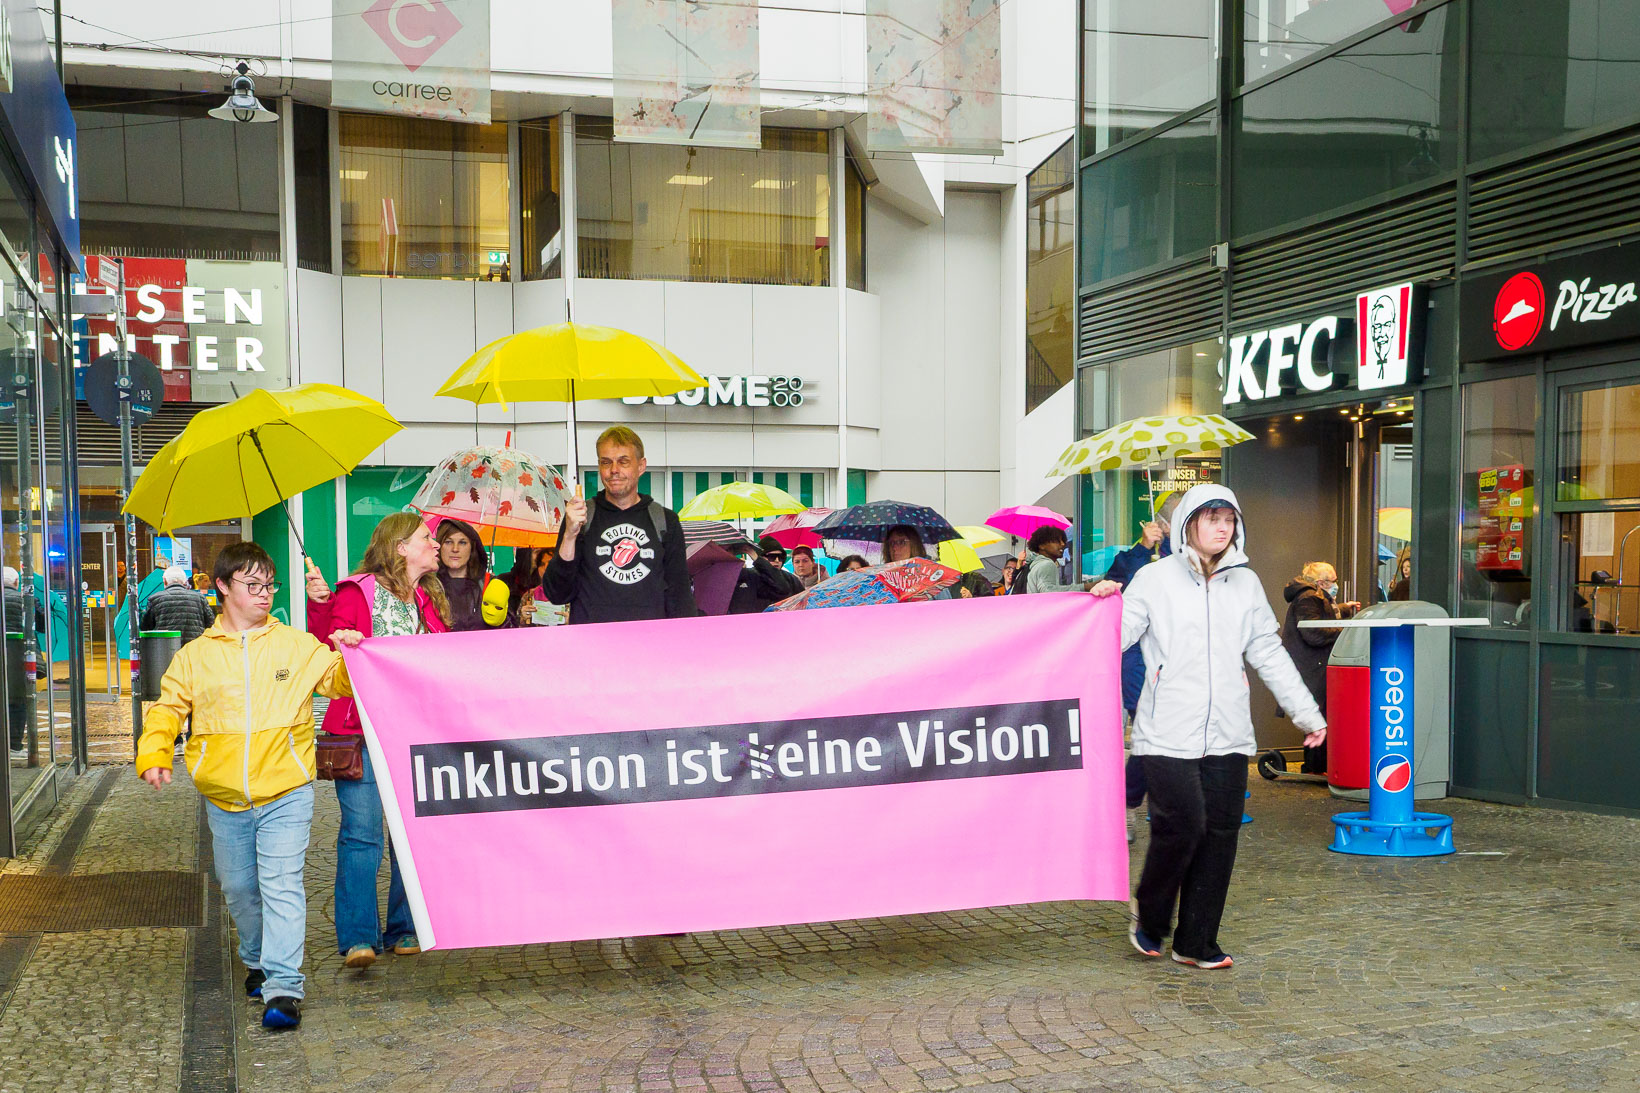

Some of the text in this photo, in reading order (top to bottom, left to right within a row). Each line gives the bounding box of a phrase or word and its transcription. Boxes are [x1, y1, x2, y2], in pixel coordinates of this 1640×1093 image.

[372, 80, 452, 102] carree
[1550, 277, 1637, 331] Pizza
[1223, 316, 1337, 404] KFC
[622, 374, 770, 406] UME
[1167, 469, 1196, 480] UNSER
[605, 526, 646, 541] ROLLING
[605, 566, 644, 581] STONES
[1380, 667, 1408, 747] pepsi
[414, 746, 646, 802] Inklusion
[666, 739, 732, 786] ist
[748, 729, 882, 780] keine
[897, 716, 1050, 768] Vision
